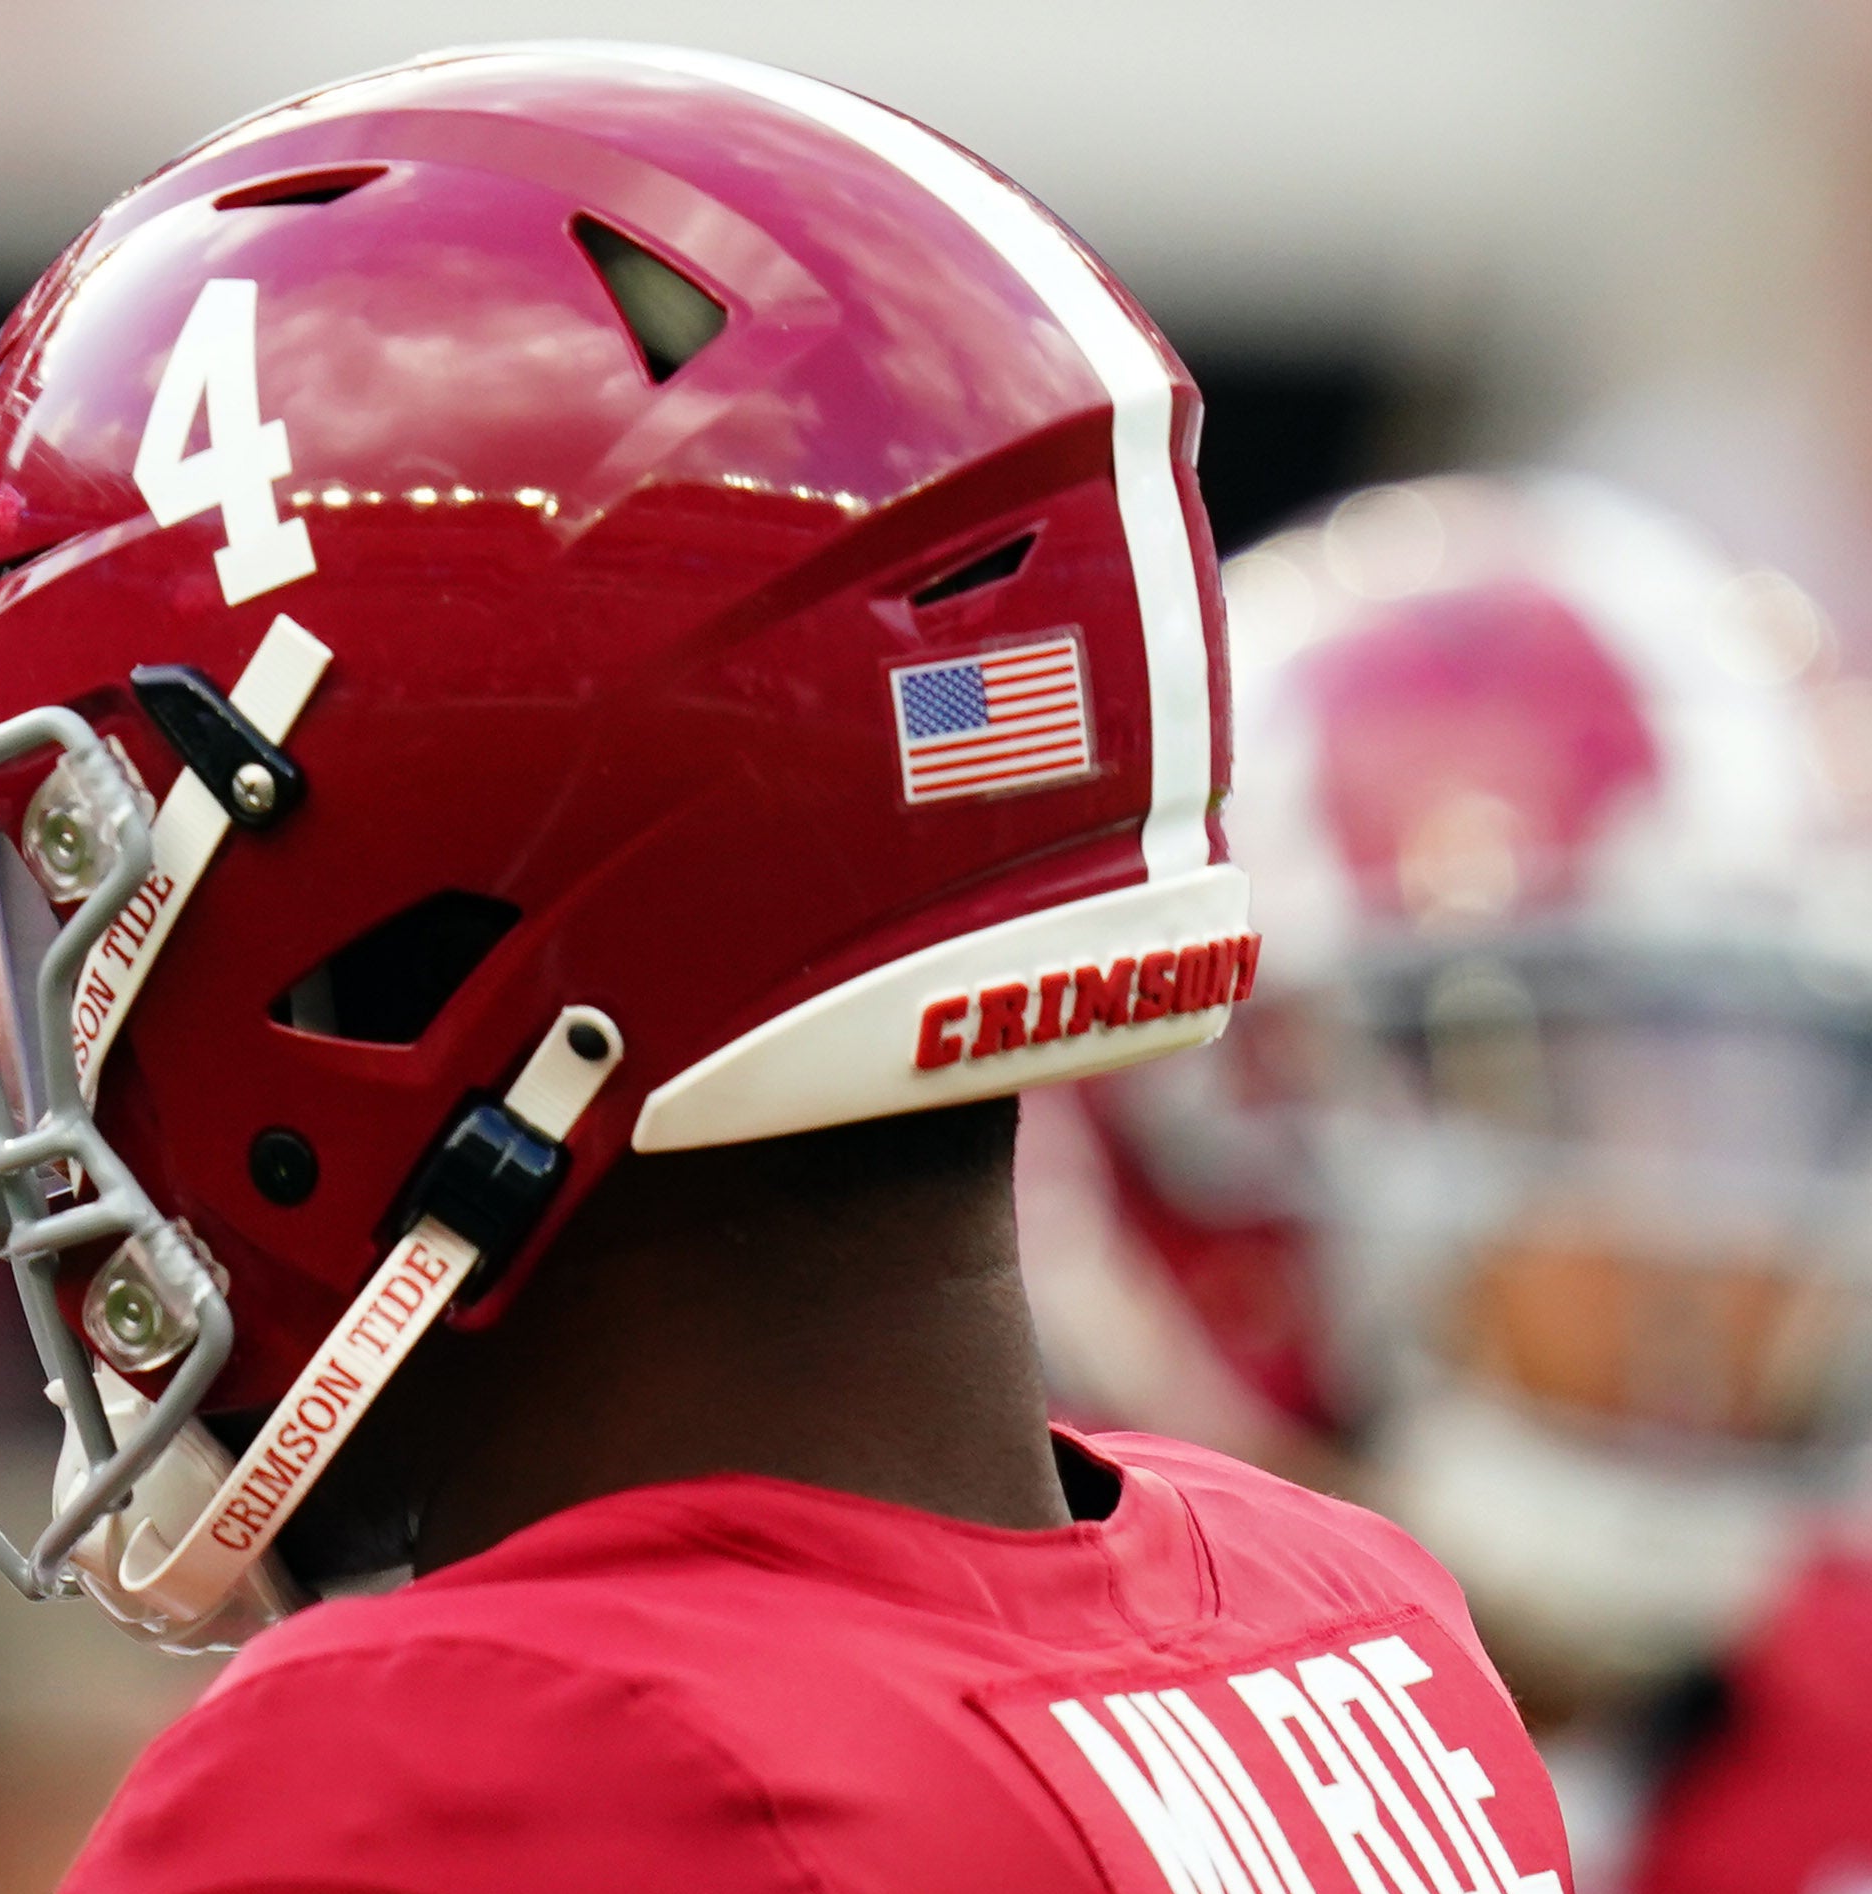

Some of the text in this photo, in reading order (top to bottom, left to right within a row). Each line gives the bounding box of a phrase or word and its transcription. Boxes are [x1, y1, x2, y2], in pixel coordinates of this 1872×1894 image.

[133, 278, 318, 607] 4
[102, 866, 176, 971] TIDE
[915, 936, 1238, 1072] CRIMSON
[210, 1242, 450, 1552] CRIMSON TIDE
